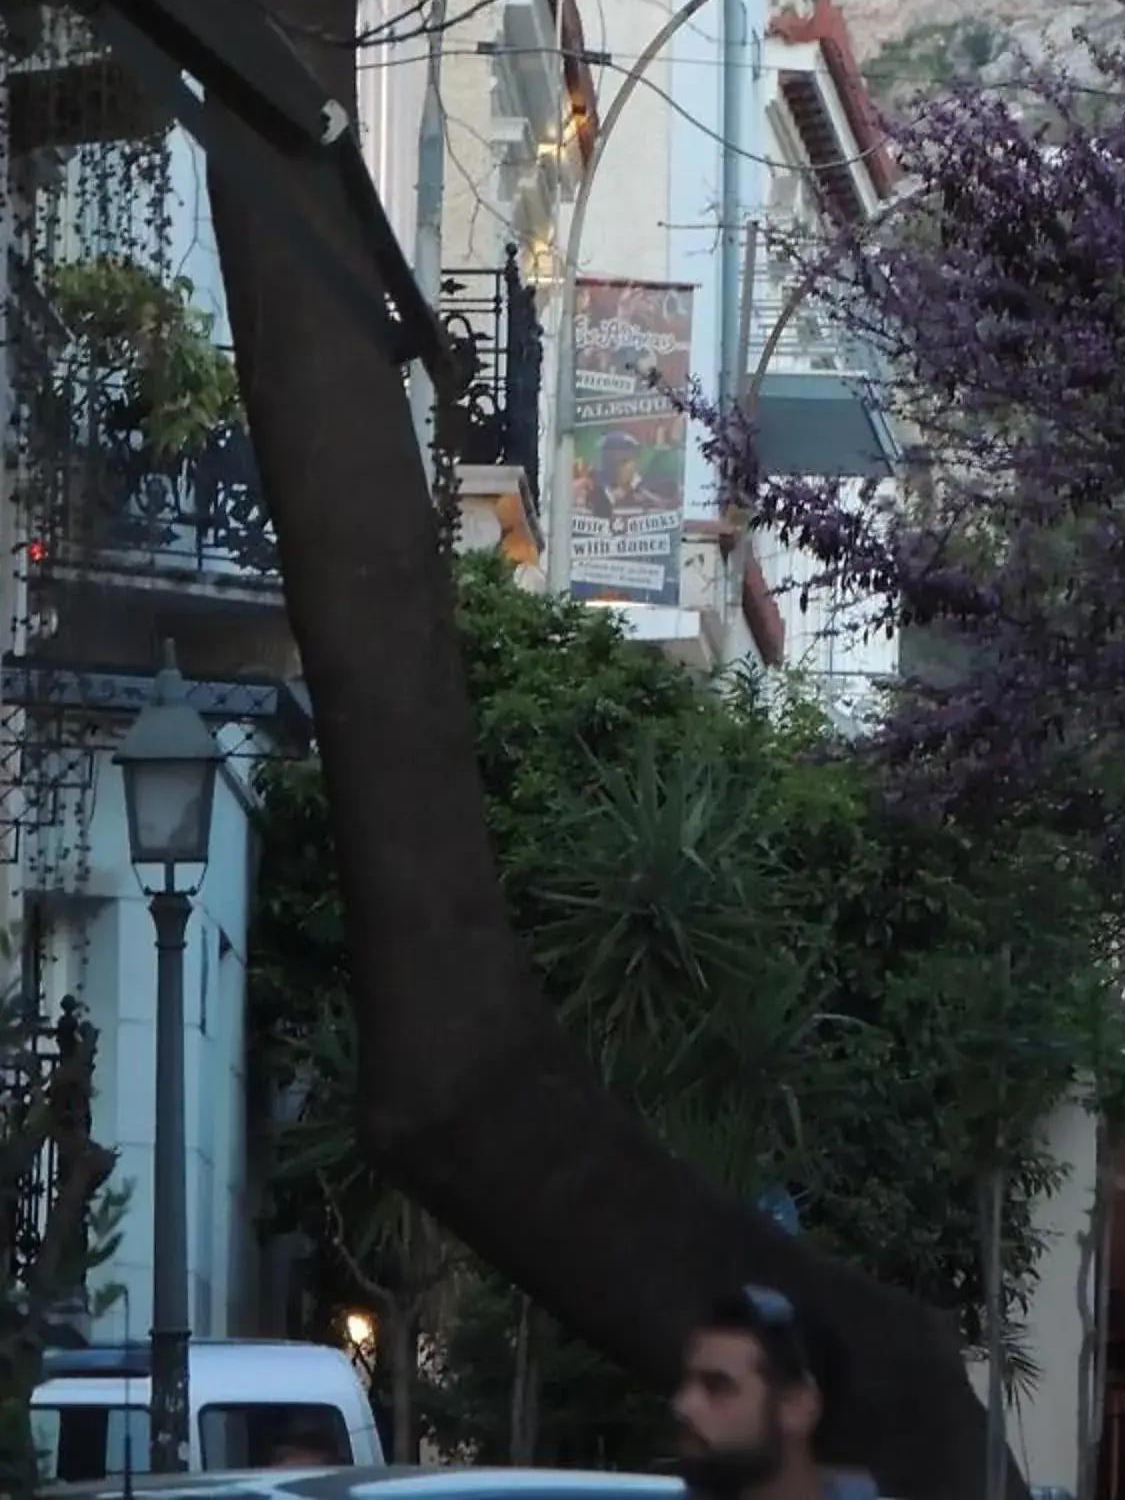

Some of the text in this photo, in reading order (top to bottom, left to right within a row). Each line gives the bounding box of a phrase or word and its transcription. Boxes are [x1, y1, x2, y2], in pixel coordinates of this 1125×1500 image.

[576, 398, 677, 418] ALENQU
[630, 515, 676, 531] drinks
[574, 537, 667, 555] with dance
